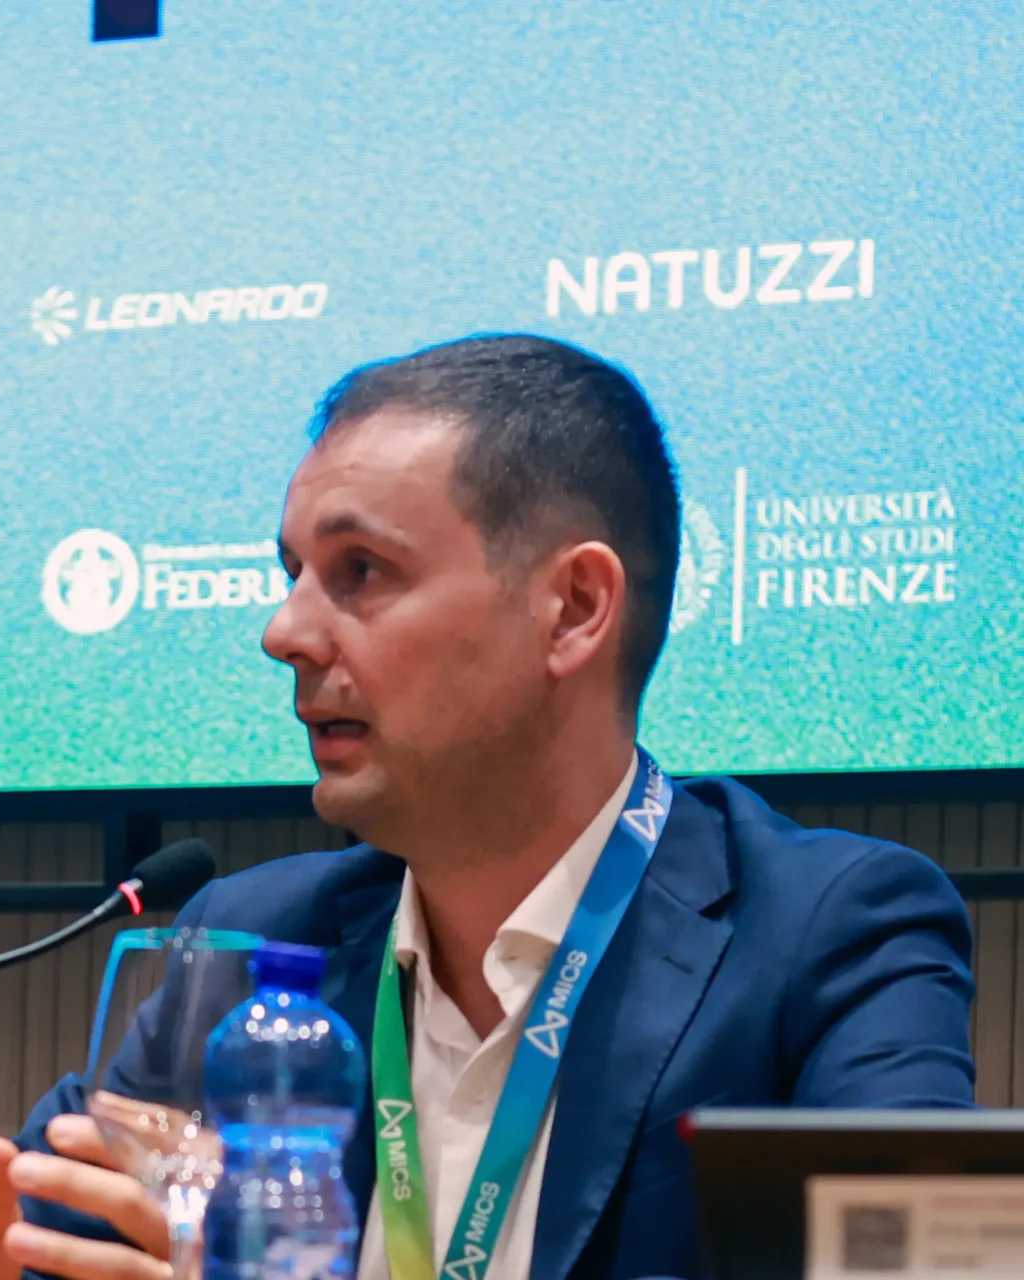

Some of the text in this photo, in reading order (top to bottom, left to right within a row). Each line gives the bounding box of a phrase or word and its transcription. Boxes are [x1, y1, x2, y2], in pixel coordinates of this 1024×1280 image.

[545, 238, 876, 318] NATUZZI
[84, 282, 329, 331] LEONARDO
[756, 486, 956, 527] UNIVERSITÀ
[756, 526, 956, 561] DEGLI STUDI
[756, 562, 957, 609] FIRENZE
[547, 949, 588, 1010] MICS
[387, 1139, 413, 1202] MICS
[464, 1181, 501, 1243] MICS
